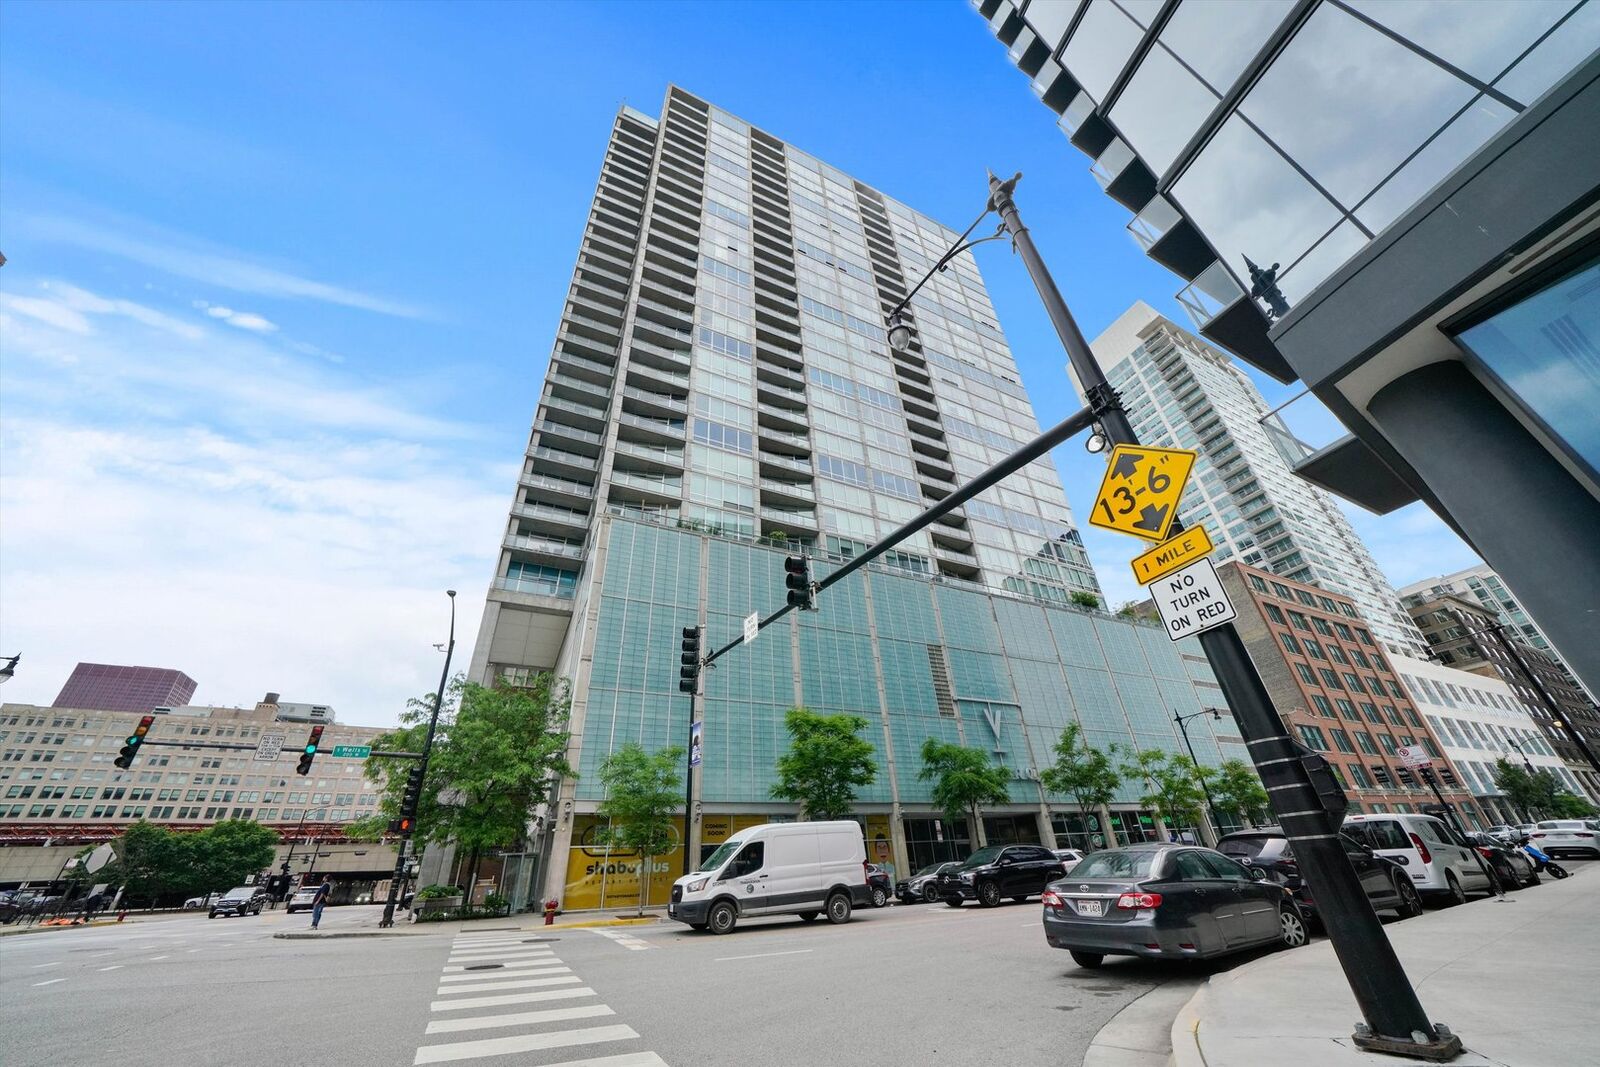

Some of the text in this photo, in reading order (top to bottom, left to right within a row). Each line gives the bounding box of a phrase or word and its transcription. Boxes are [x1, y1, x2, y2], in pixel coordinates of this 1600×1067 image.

[1143, 539, 1196, 573] 1 MILE
[1170, 574, 1195, 593] NO
[1170, 586, 1211, 612] TURN
[1171, 601, 1226, 632] ON RED
